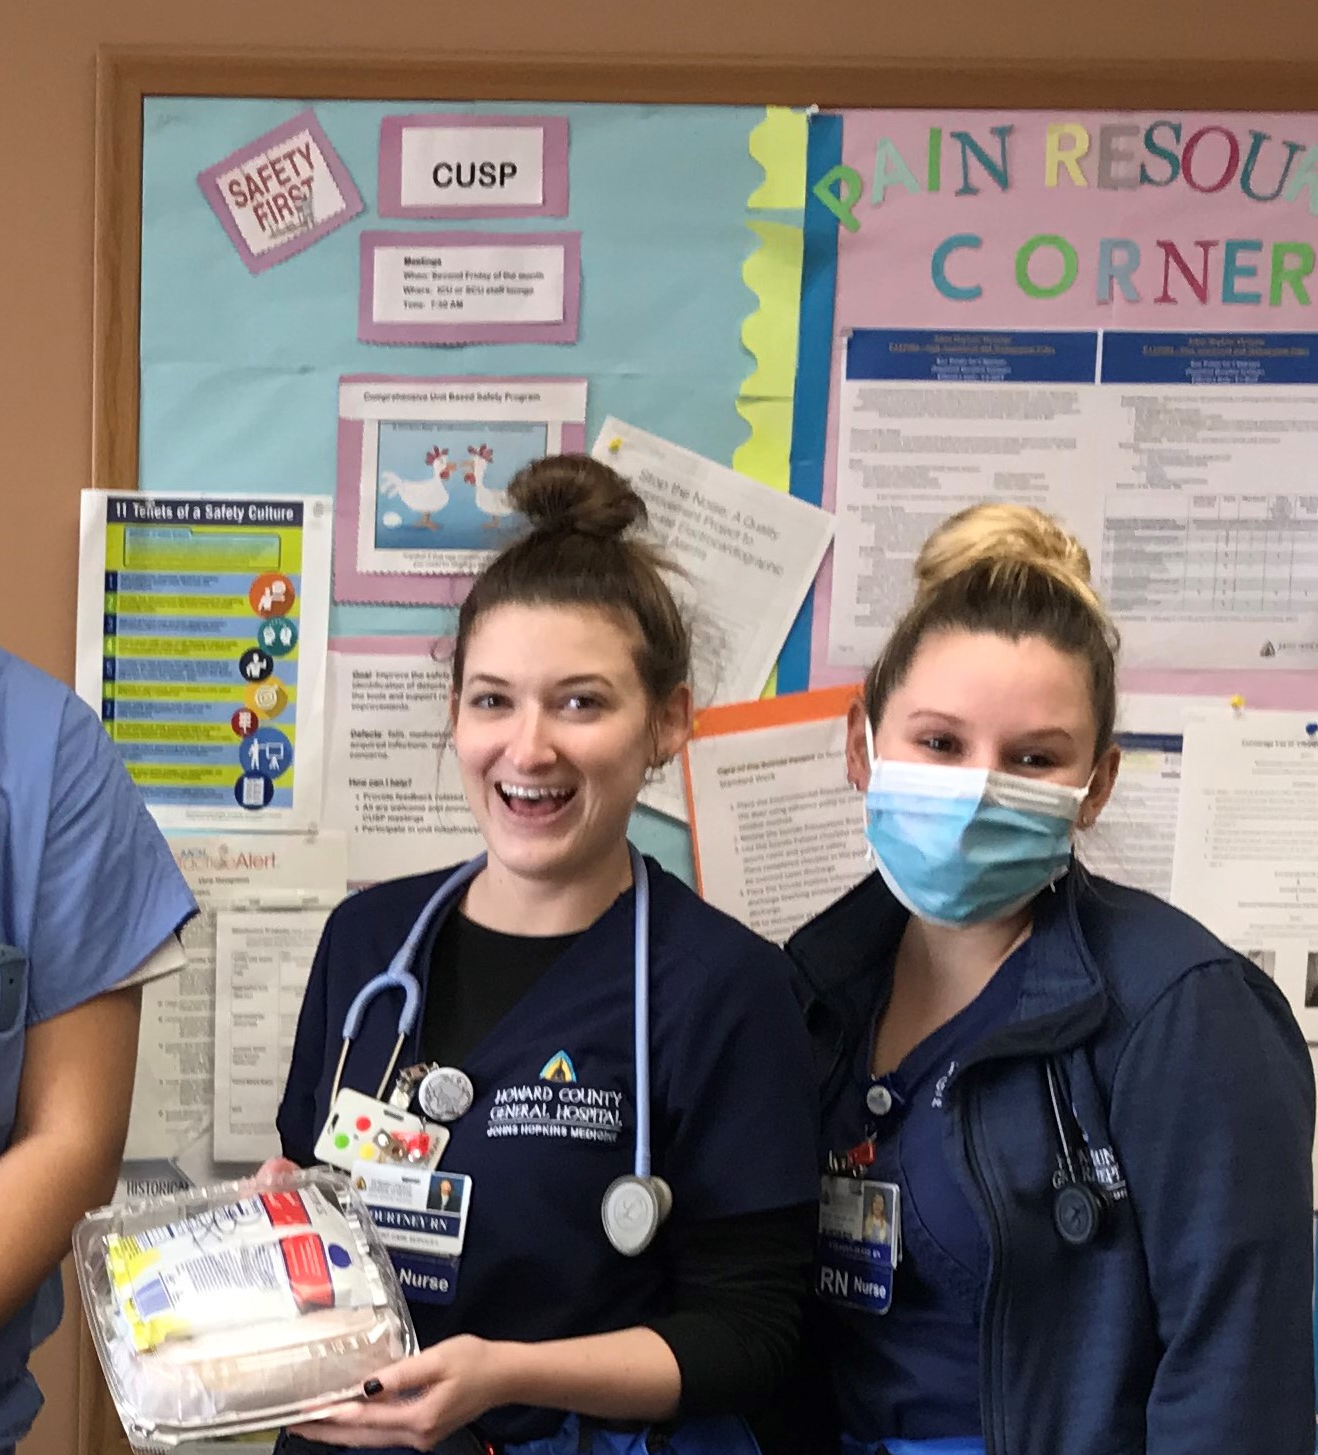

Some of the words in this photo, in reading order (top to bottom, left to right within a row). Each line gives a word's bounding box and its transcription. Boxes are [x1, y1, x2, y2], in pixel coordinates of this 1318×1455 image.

[227, 141, 316, 210] SAFETY
[432, 161, 518, 189] CUSP
[813, 124, 1014, 233] PAIN
[252, 175, 316, 231] FIRST
[930, 233, 1318, 307] CORNER
[363, 391, 428, 403] Comprehensive
[476, 391, 503, 403] Safety
[504, 391, 541, 403] Program
[116, 502, 127, 518] 11
[134, 502, 173, 520] Tenets
[176, 503, 189, 519] of
[192, 505, 202, 519] a
[205, 503, 245, 524] Safety
[248, 504, 295, 522] Culture
[494, 1085, 553, 1105] HOWARD
[558, 1087, 623, 1107] COUNTY
[490, 1102, 550, 1121] GENERAL
[556, 1103, 623, 1127] HOSPITAL
[487, 1125, 518, 1138] JOHNS
[520, 1124, 568, 1137] HOPKINS
[429, 1217, 449, 1232] RN
[399, 1267, 450, 1294] Nurse
[820, 1265, 849, 1298] RN
[853, 1275, 887, 1300] Nurse
